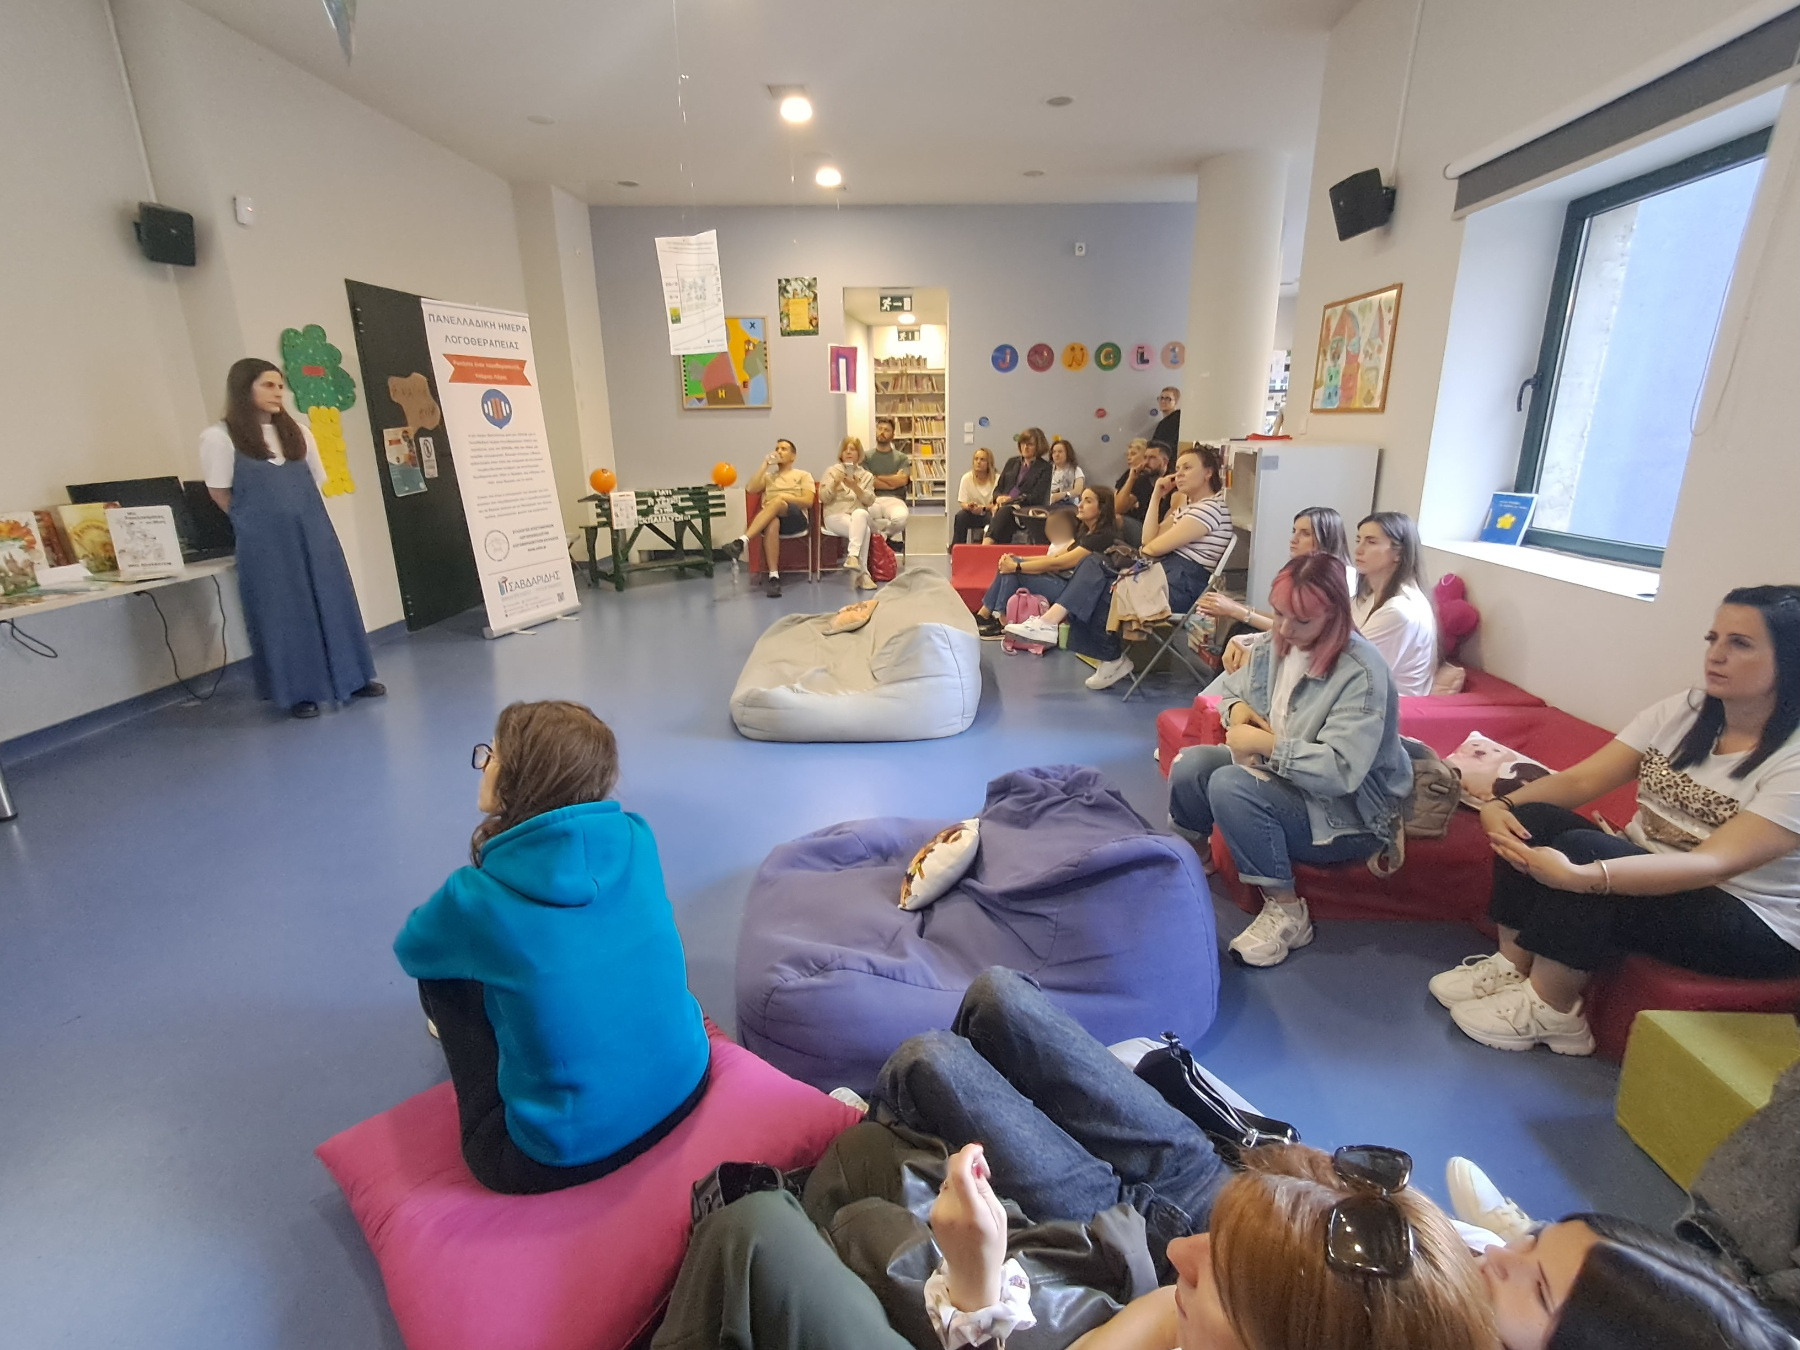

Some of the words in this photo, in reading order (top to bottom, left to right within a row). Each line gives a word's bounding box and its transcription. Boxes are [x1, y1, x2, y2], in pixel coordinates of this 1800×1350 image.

[428, 313, 496, 330] ΠΑΝΕΛΛΑΔΙΚΗ
[498, 322, 528, 333] ΗΜΕΡΑ
[444, 334, 519, 350] ΛΟΓΟΘΕΡΑΠΕΙΑΣ
[502, 570, 561, 593] ΤΣΑΒΔΑΡΙΔΗΣ
